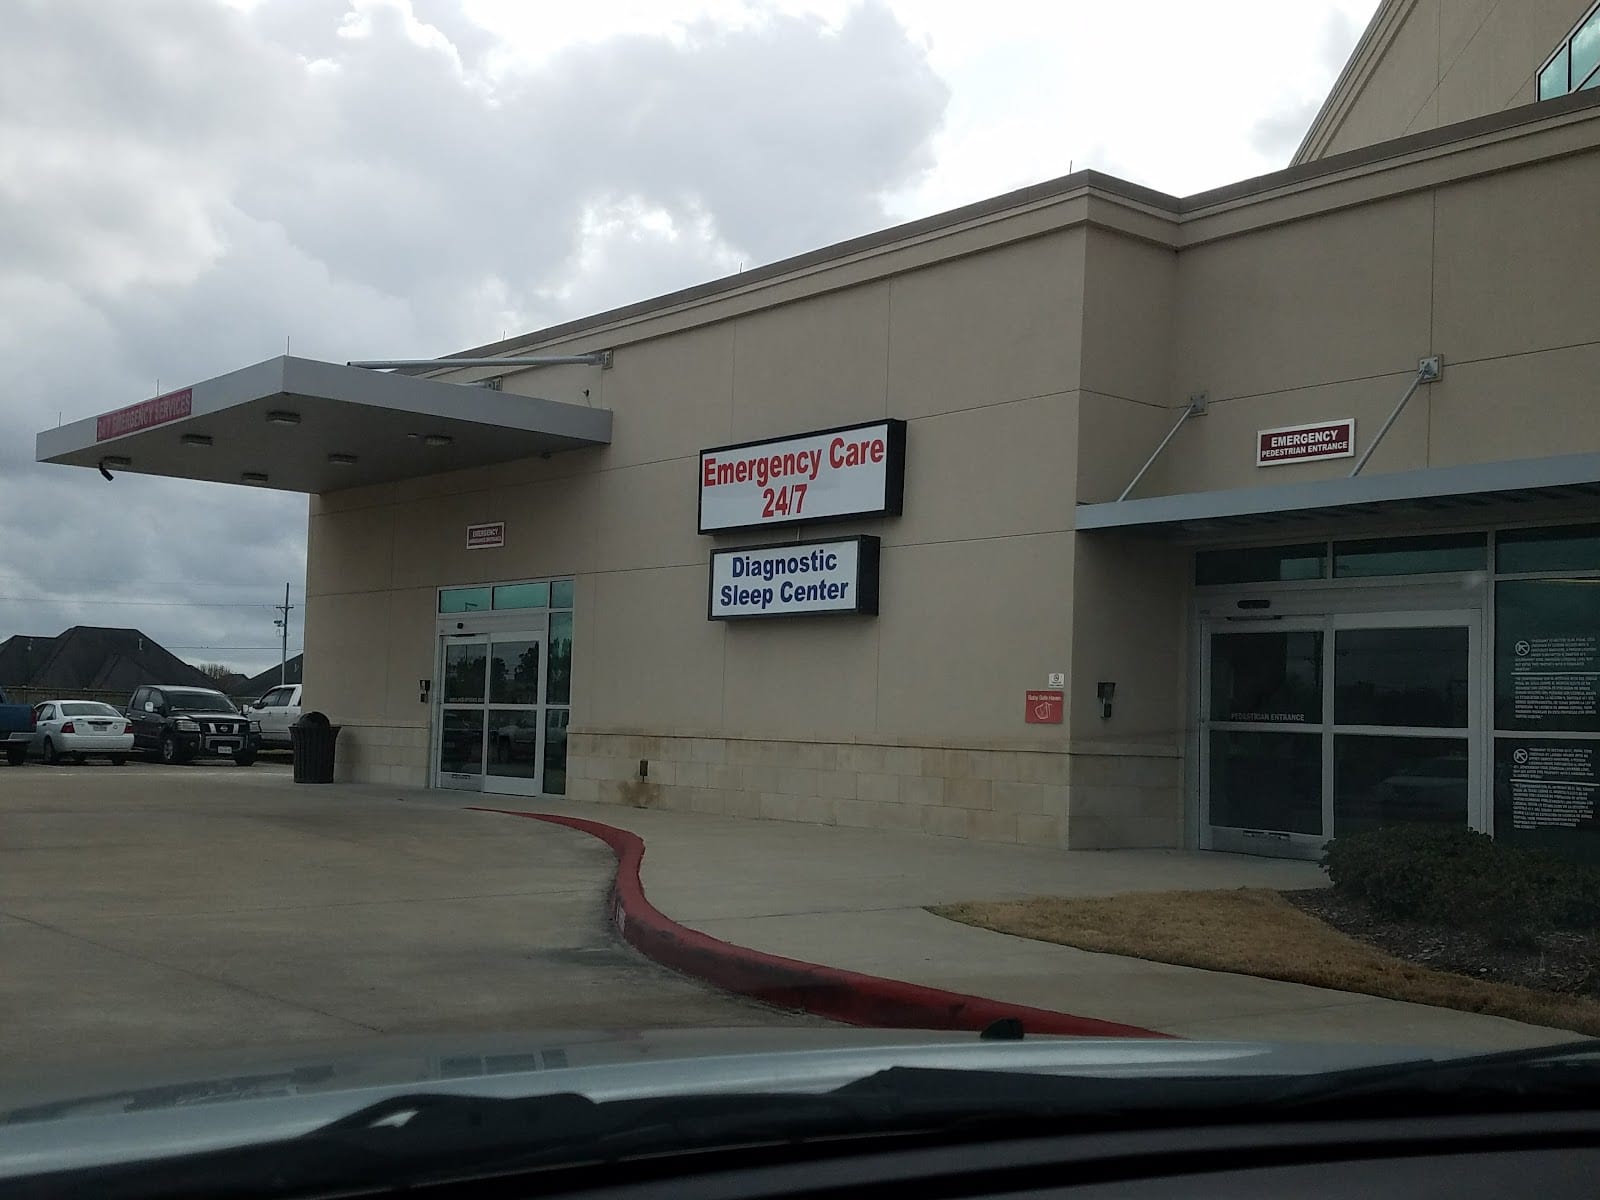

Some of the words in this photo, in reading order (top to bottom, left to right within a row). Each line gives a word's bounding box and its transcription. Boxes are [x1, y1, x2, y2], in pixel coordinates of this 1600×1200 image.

[1262, 446, 1306, 458] PEDESTRIAN
[1308, 441, 1347, 452] ENTRANCE
[1271, 430, 1338, 447] EMERGENCY
[704, 449, 822, 487] Emergency
[829, 438, 884, 469] Care
[762, 484, 807, 517] 24/7
[732, 550, 837, 581] Diagnostic
[721, 585, 773, 609] Sleep
[780, 579, 848, 602] Center
[1270, 713, 1304, 721] ENTRANCE
